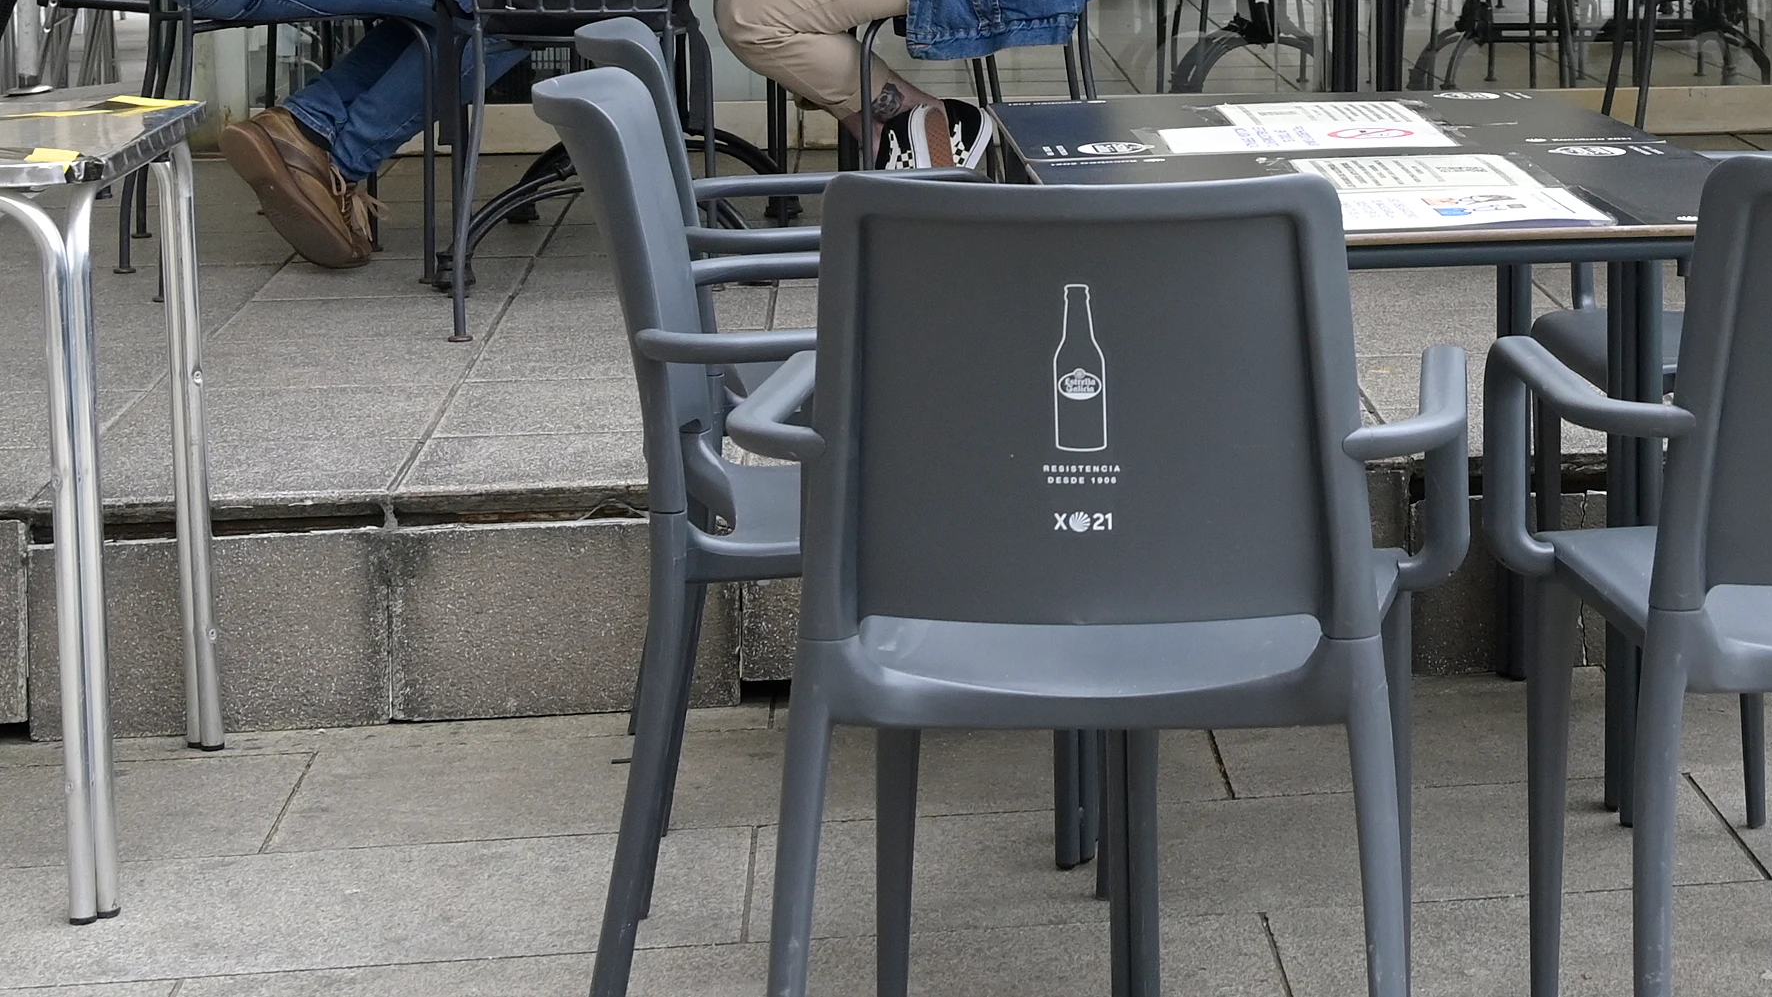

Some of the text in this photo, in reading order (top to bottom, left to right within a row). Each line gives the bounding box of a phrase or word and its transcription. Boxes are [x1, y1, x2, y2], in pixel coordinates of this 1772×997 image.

[1064, 377, 1096, 386] Estrella
[1065, 385, 1095, 393] Galicia
[1042, 464, 1121, 473] RESISTENCIA
[1047, 476, 1117, 484] DESDE 1906
